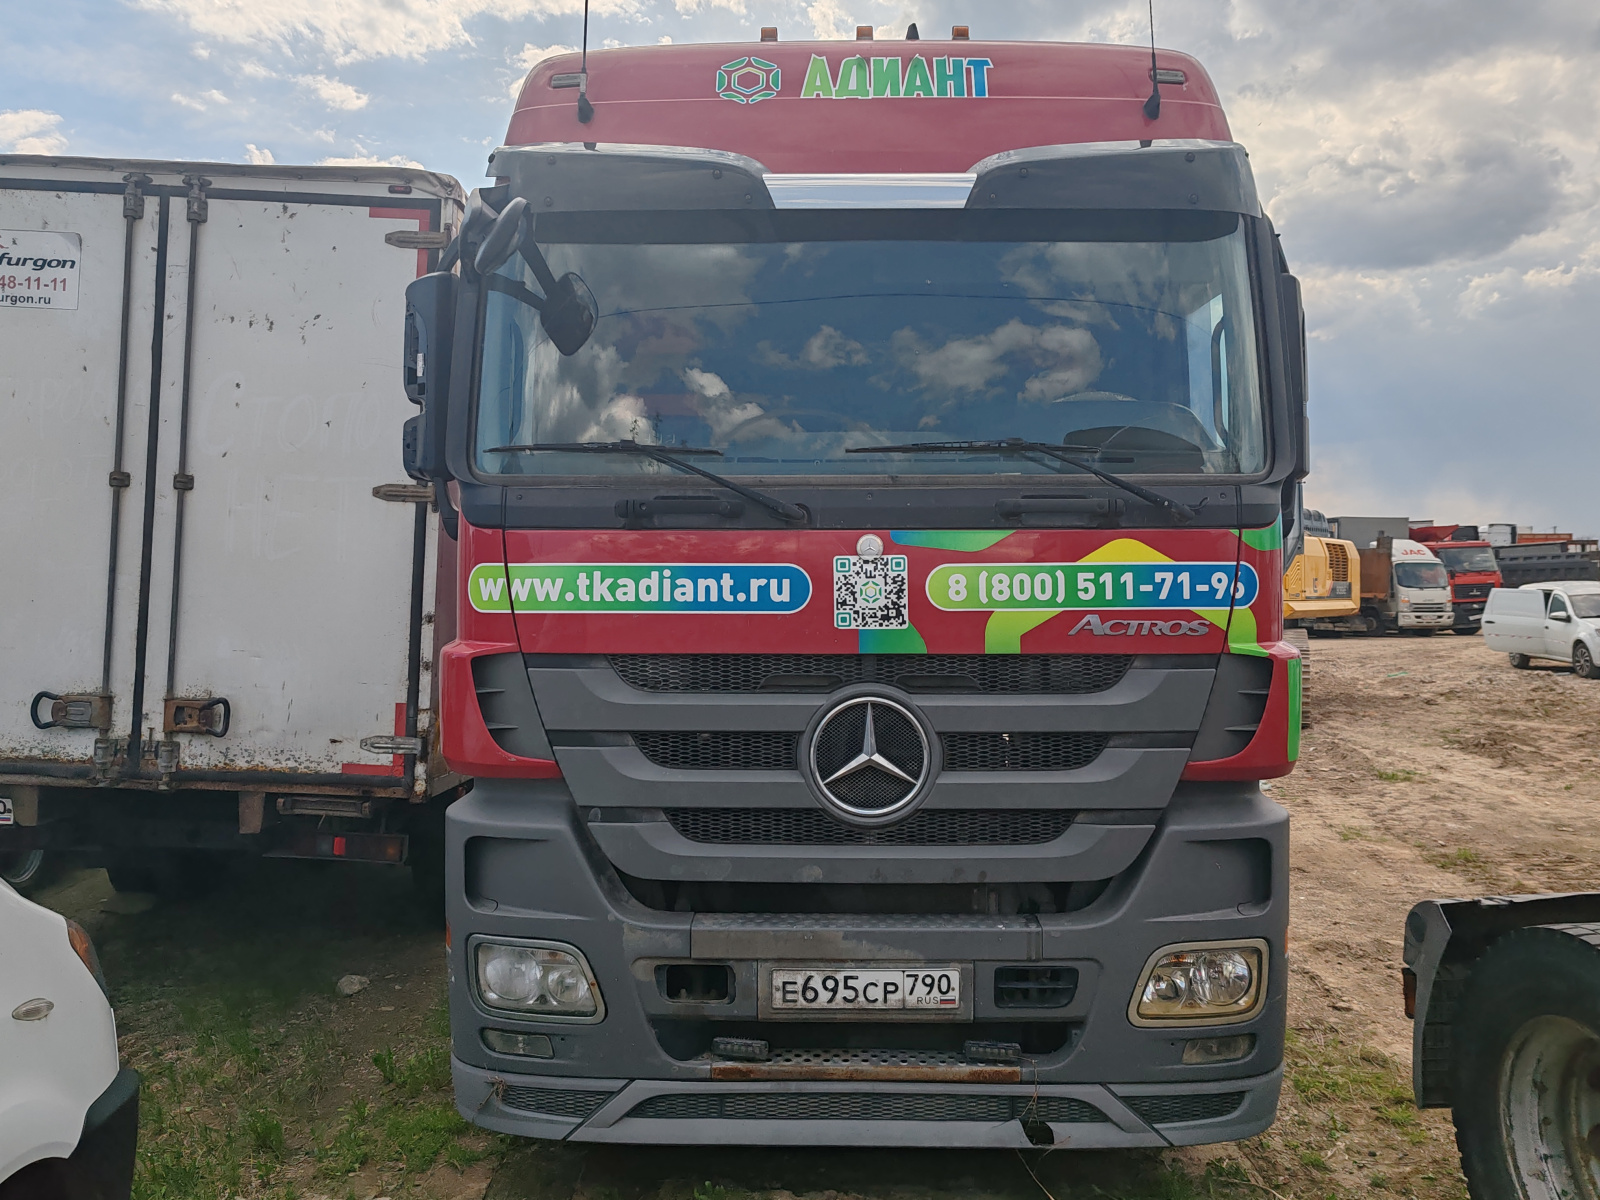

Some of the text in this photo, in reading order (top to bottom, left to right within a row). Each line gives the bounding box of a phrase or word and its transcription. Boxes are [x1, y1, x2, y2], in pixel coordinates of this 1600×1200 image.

[800, 54, 994, 99] АДИАНТ
[478, 570, 791, 604] www.tkadiant.ru
[947, 570, 1246, 604] 8 (800) 511-71-96
[916, 996, 939, 1005] RUS
